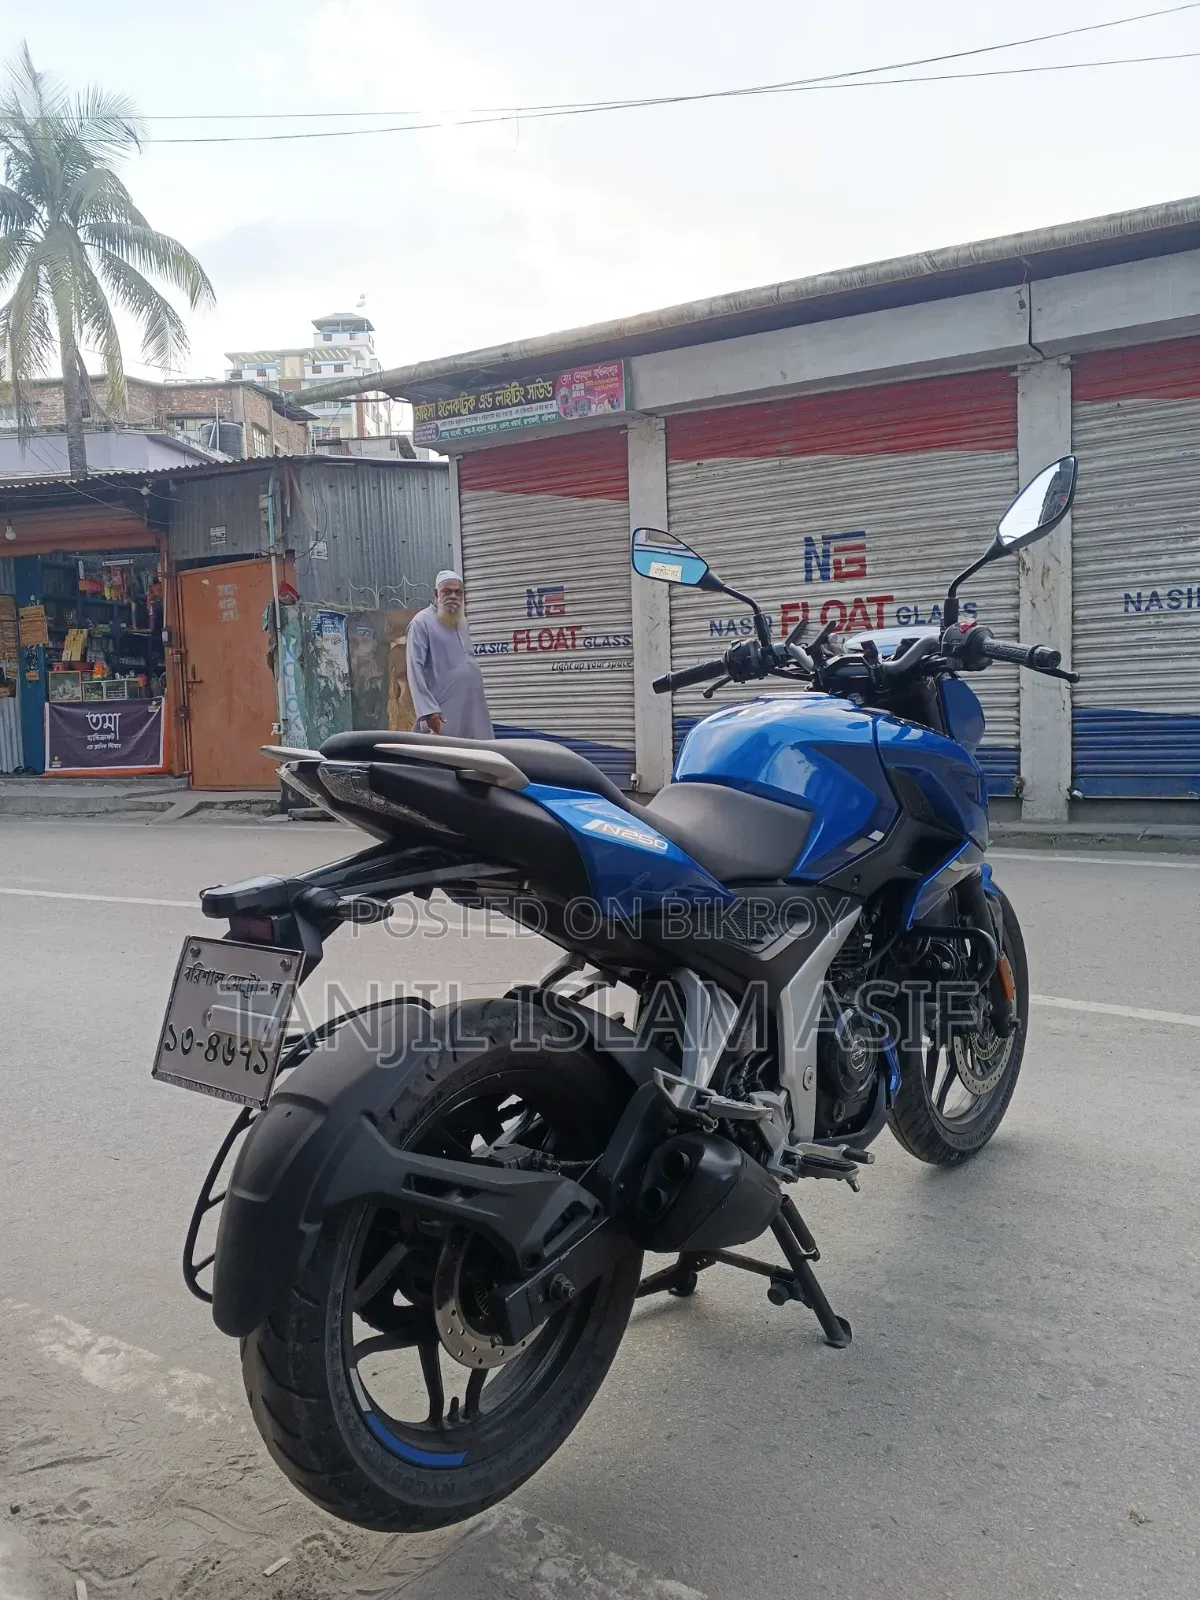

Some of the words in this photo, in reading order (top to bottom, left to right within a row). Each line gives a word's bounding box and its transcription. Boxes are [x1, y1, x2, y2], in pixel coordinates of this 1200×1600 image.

[495, 381, 526, 406] লাইটিং
[709, 616, 773, 637] NASR
[896, 601, 979, 626] GLAS
[512, 625, 583, 653] FLOAT
[583, 634, 632, 648] GLASS
[552, 661, 572, 673] Light
[574, 662, 585, 672] up
[587, 661, 606, 671] your
[86, 711, 122, 740] তমা
[602, 822, 668, 850] N250
[184, 962, 226, 987] বরিশাল
